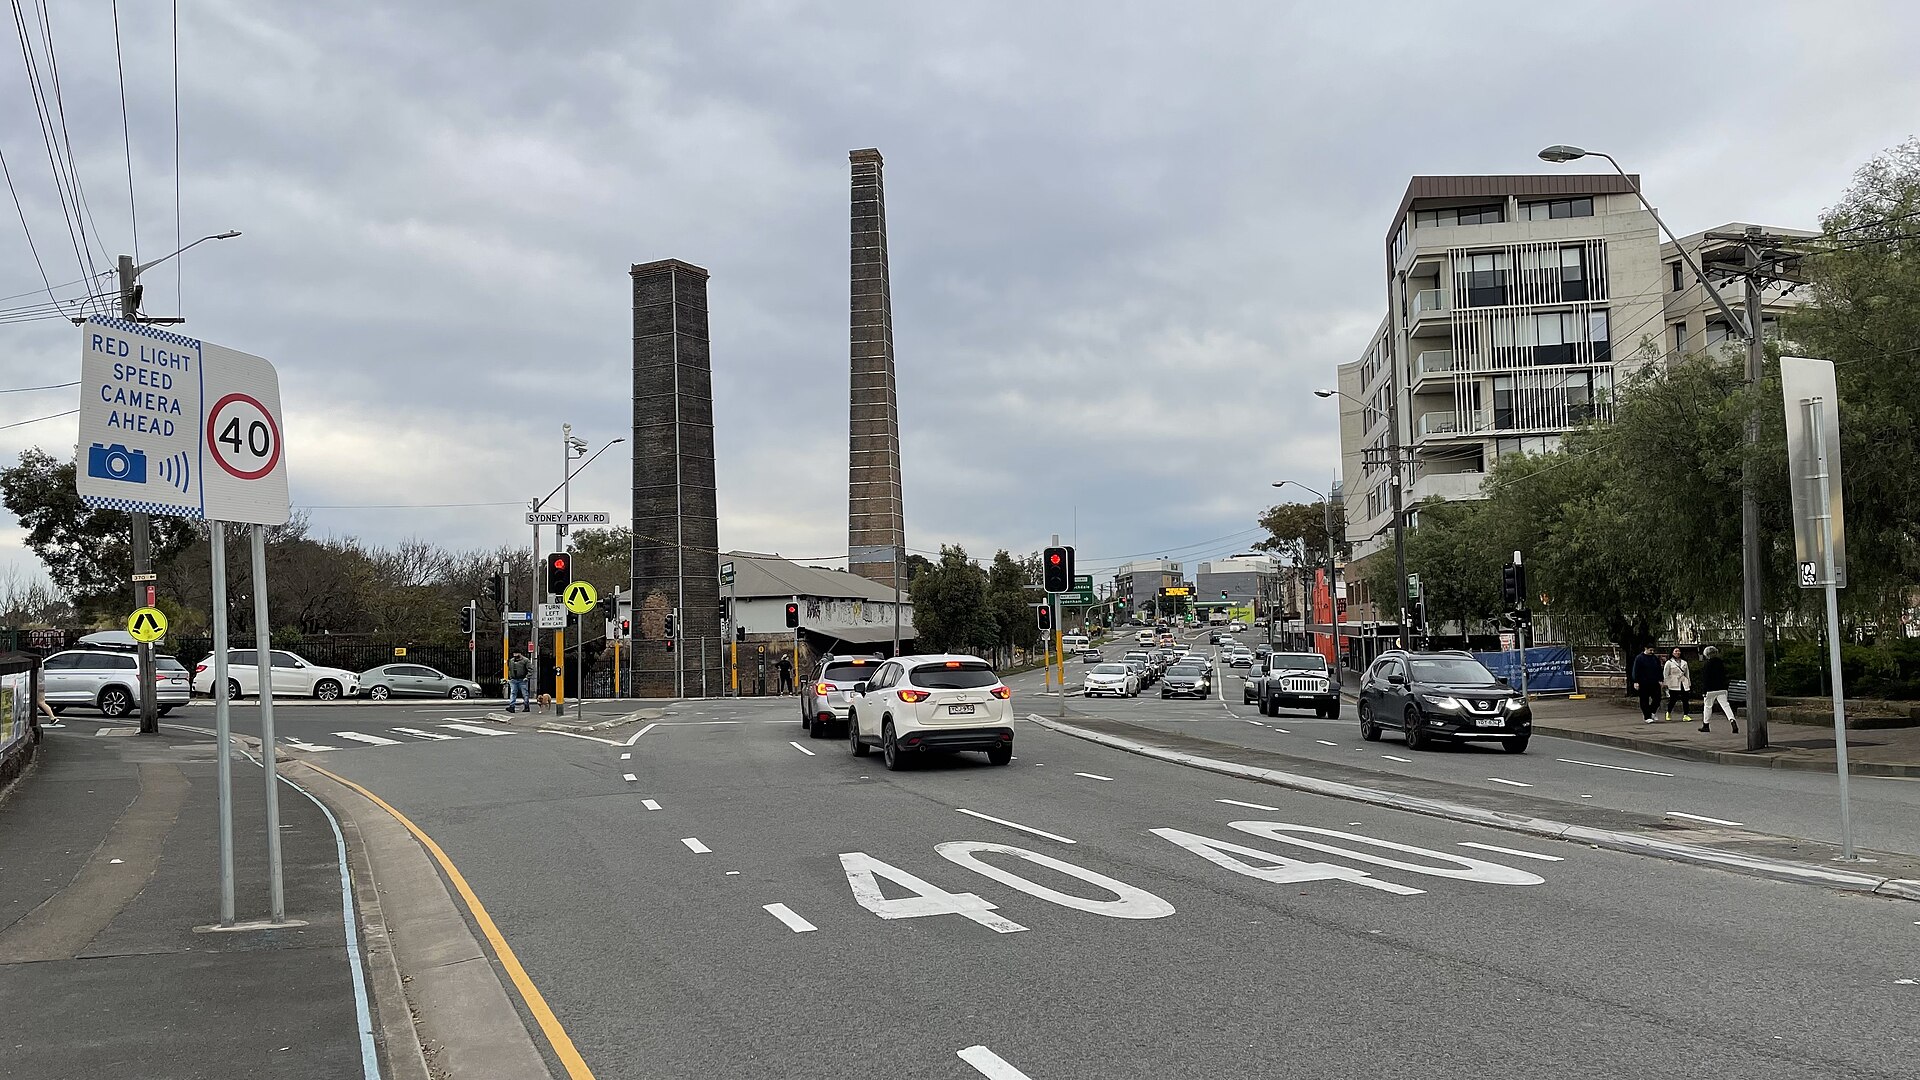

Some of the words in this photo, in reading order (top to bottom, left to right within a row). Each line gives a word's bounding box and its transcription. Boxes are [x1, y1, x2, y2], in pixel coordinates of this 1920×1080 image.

[92, 334, 129, 357] RED
[140, 345, 190, 372] LIGHT
[113, 363, 172, 390] SPEED
[101, 384, 182, 416] CAMERA
[108, 410, 174, 437] AHEAD
[219, 417, 270, 457] 40
[529, 514, 562, 522] SYDNEY
[567, 514, 589, 522] PARK
[594, 514, 605, 522] RD
[1148, 820, 1545, 895] 40
[838, 841, 1176, 933] 40
